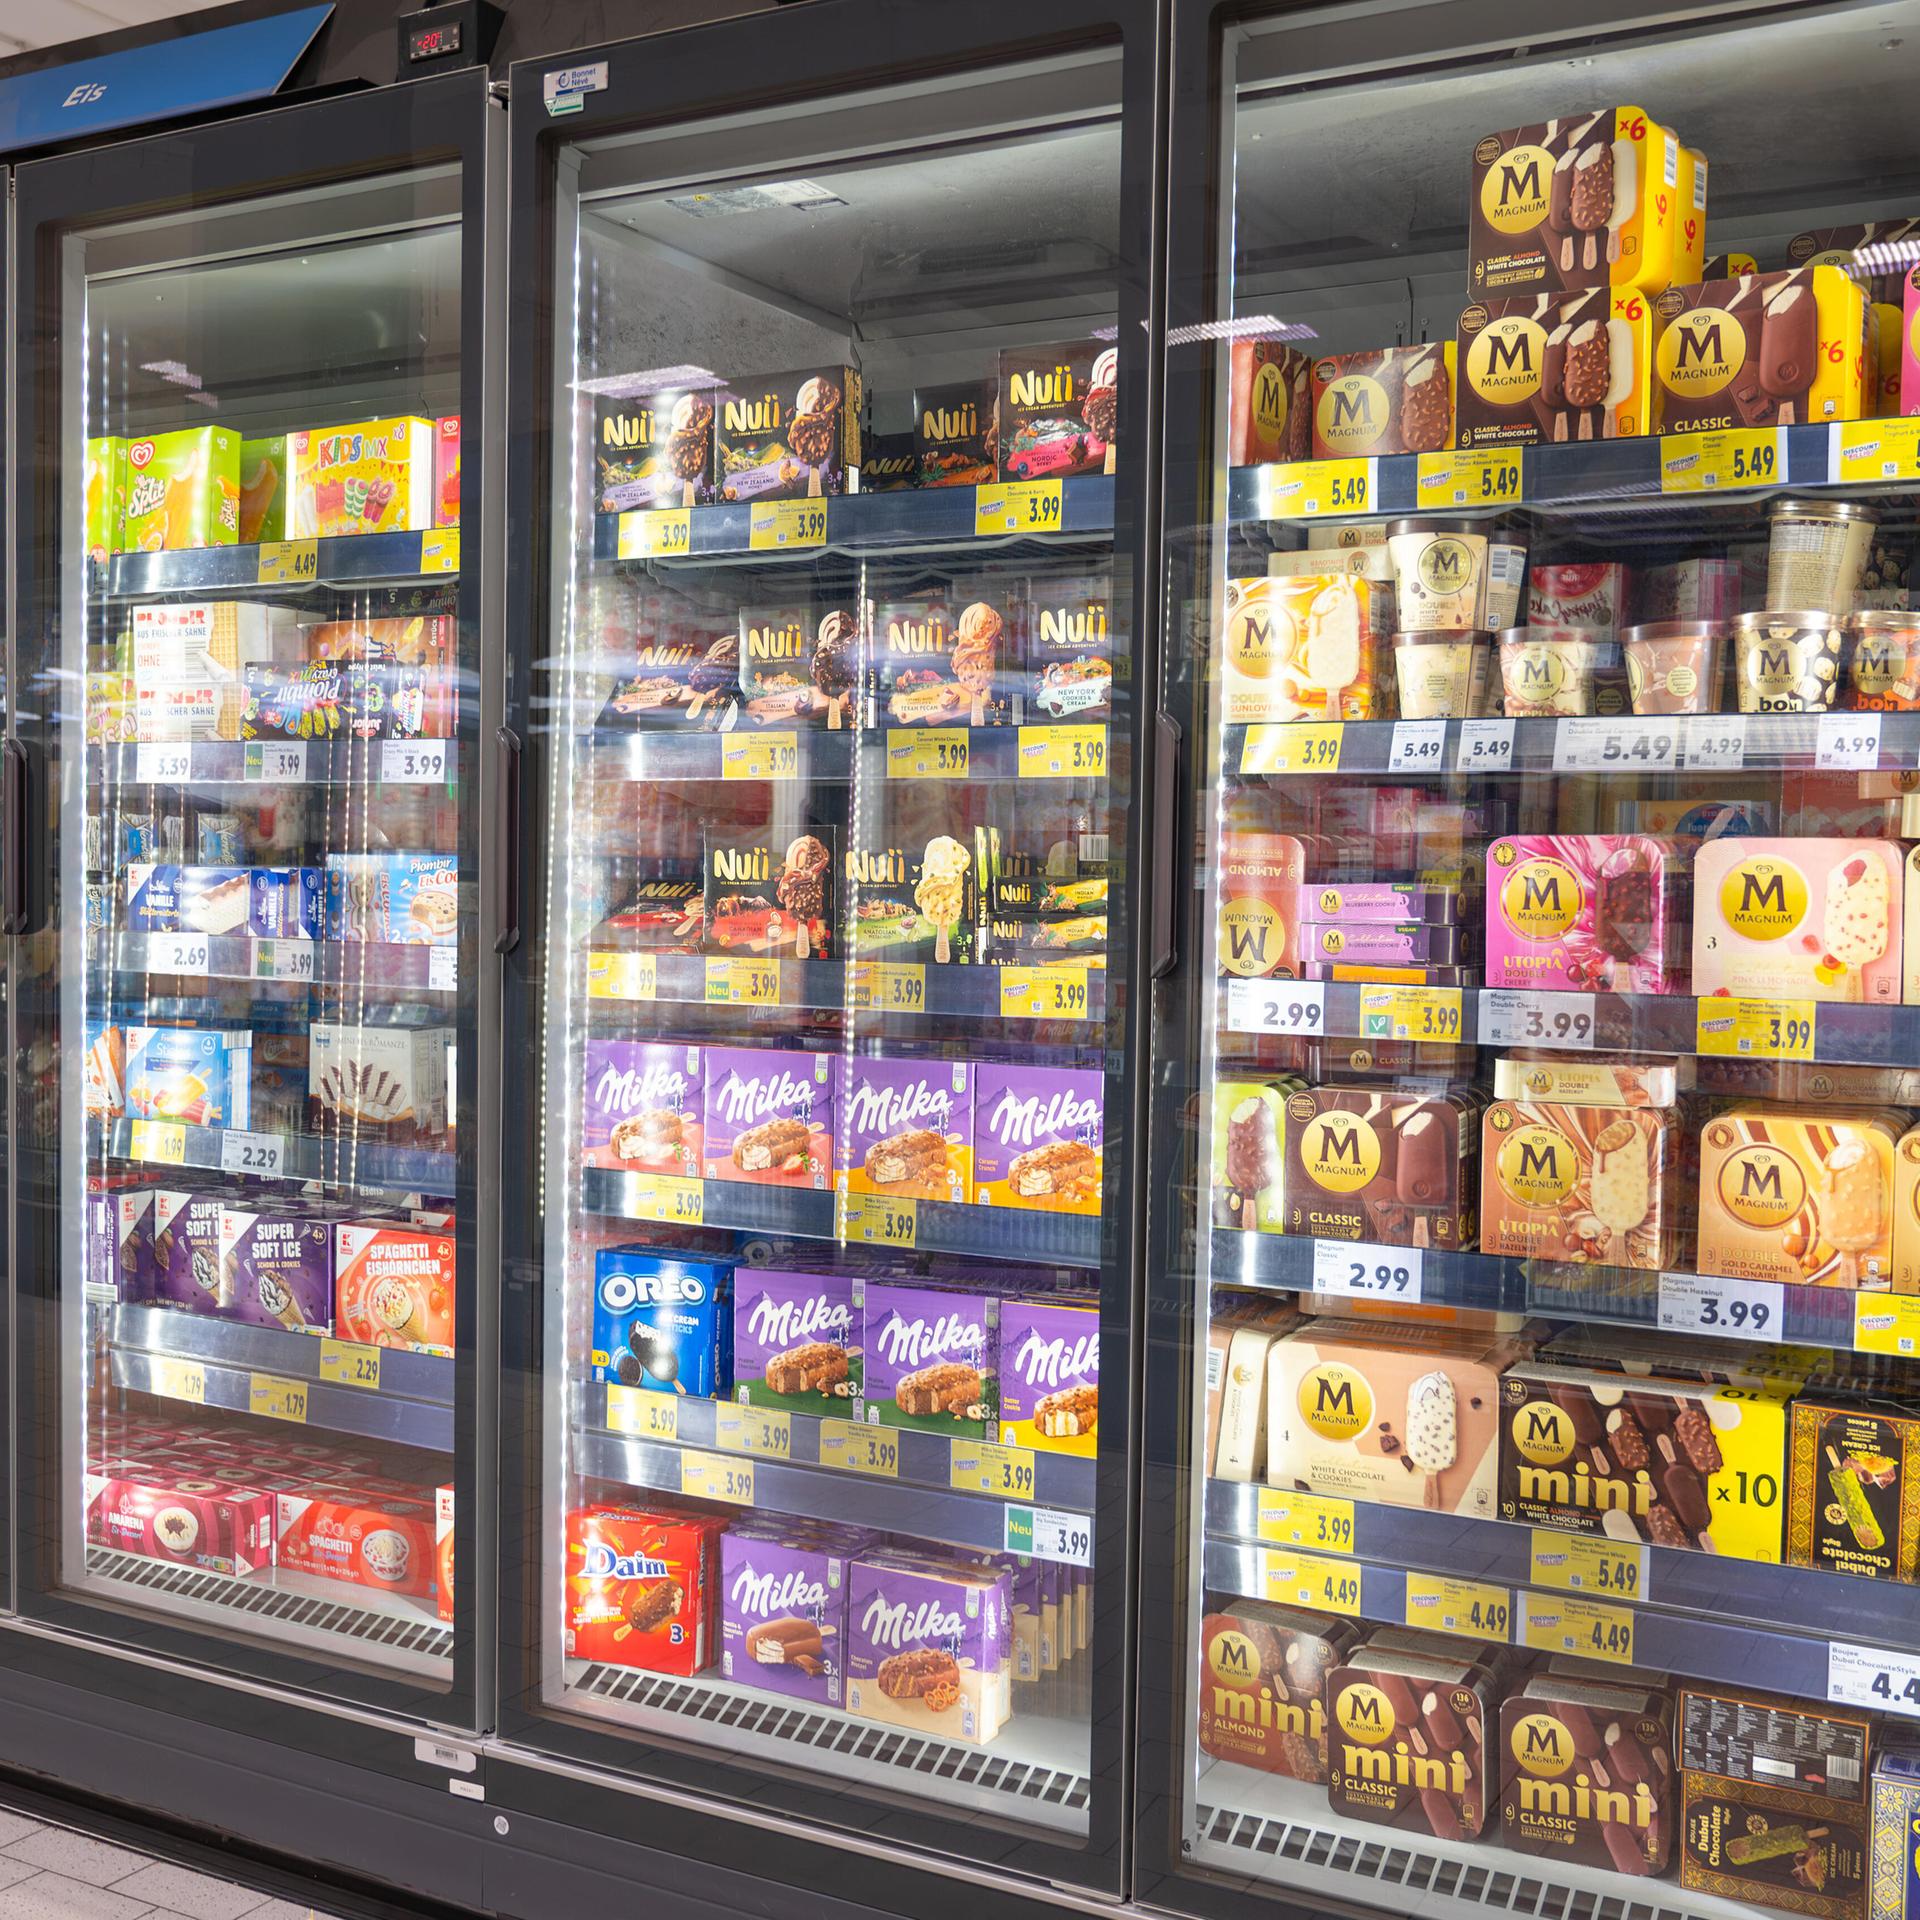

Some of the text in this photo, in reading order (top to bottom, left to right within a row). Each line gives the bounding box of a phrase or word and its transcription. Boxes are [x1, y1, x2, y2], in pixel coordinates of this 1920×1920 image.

[63, 83, 107, 107] Eis
[1493, 200, 1548, 219] MAGNUM
[1486, 250, 1541, 265] CLASSIC ALMOND
[1481, 372, 1539, 388] MAGNUM
[1670, 365, 1731, 381] MAGNUM
[1010, 365, 1073, 407] Nuii
[724, 394, 780, 432] Nuii
[923, 401, 977, 441] Nuii
[1326, 424, 1378, 439] MAGNUM
[320, 434, 362, 470] KIDS
[1702, 441, 1722, 449] Classic
[1031, 454, 1057, 462] NORDIC
[1733, 445, 1774, 479] 5.49
[1331, 477, 1366, 506] 5.49
[1481, 466, 1519, 497] 5.49
[1029, 495, 1059, 523] 3.99
[797, 512, 825, 539] 3.99
[295, 552, 316, 574] 4.49
[1039, 605, 1106, 645] Nuii
[748, 624, 801, 661] Nuii
[889, 618, 943, 654] Nuii
[1520, 682, 1555, 690] MAGNUM
[1756, 675, 1796, 684] MAGNUM
[1856, 674, 1894, 683] MAGNUM
[272, 678, 341, 704] Plombir
[1057, 688, 1096, 696] NEW YORK
[191, 706, 215, 716] SAHNE
[1073, 741, 1104, 767] 3.99
[1472, 740, 1511, 757] 5.49
[1701, 738, 1743, 754] 4.99
[1834, 736, 1877, 753] 4.99
[157, 757, 189, 776] 3.39
[279, 754, 300, 775] 3.99
[404, 755, 443, 775] 3.99
[769, 746, 796, 772] 3.99
[937, 744, 967, 769] 3.99
[410, 858, 453, 873] Plombir
[713, 846, 769, 882] Nuii
[419, 875, 434, 887] Eis
[145, 894, 175, 908] VANILLE
[1000, 883, 1031, 902] Nuii
[267, 891, 278, 930] VANILLE
[1517, 911, 1567, 921] MAGNUM
[1734, 912, 1793, 924] MAGNUM
[992, 920, 1023, 938] Nuii
[290, 954, 312, 975] 3.99
[1503, 953, 1564, 970] UTOPIA
[1503, 978, 1532, 987] CHERRY
[1505, 968, 1547, 978] DOUBLE
[708, 983, 729, 996] Neu
[750, 973, 777, 997] 3.99
[893, 979, 922, 1004] 3.99
[1055, 984, 1085, 1009] 3.99
[1490, 993, 1521, 1001] Magnum
[1490, 1000, 1540, 1010] Double Cherry
[1263, 1001, 1321, 1028] 2.99
[1423, 1006, 1459, 1035] 3.99
[1525, 1012, 1591, 1040] 3.99
[1769, 1019, 1811, 1049] 3.99
[1379, 1057, 1412, 1065] CLASSIC
[595, 1065, 688, 1114] Milka
[716, 1071, 816, 1123] Milka
[849, 1080, 953, 1134] Milka
[989, 1089, 1103, 1146] Milka
[164, 1139, 183, 1156] 1.99
[242, 1146, 277, 1168] 2.29
[978, 1158, 999, 1166] Caramel
[1314, 1163, 1368, 1177] MAGNUM
[1513, 1176, 1563, 1190] MAGNUM
[1734, 1196, 1789, 1211] MAGNUM
[186, 1220, 210, 1237] SOFT
[885, 1213, 914, 1239] 3.99
[1309, 1212, 1362, 1227] CLASSIC
[1499, 1220, 1559, 1237] UTOPIA
[256, 1223, 295, 1241] SUPER
[312, 1231, 324, 1240] 4x
[252, 1241, 302, 1260] SOFT ICE
[370, 1243, 430, 1259] SPAGHETTI
[437, 1246, 450, 1256] 4x
[1316, 1242, 1345, 1253] Magnum
[1316, 1250, 1339, 1259] Classic
[1499, 1242, 1537, 1253] HAZELNUT
[365, 1259, 441, 1275] EISHÖRNCHEN
[1721, 1259, 1794, 1274] GOLD CARAMEL
[1721, 1268, 1778, 1280] BILLIONAIRE
[1349, 1263, 1410, 1292] 2.99
[1662, 1276, 1695, 1286] Magnum
[602, 1275, 704, 1309] OREO
[1662, 1285, 1723, 1298] Double Hazelnut
[747, 1294, 853, 1347] Milka
[1700, 1298, 1771, 1330] 3.99
[1860, 1316, 1896, 1325] DISCOUNT
[877, 1313, 987, 1366] Milka
[597, 1354, 607, 1363] x3
[356, 1358, 378, 1380] 2.29
[184, 1375, 202, 1395] 1.79
[285, 1391, 305, 1416] 1.79
[650, 1407, 675, 1433] 3.99
[1311, 1411, 1360, 1427] MAGNUM
[762, 1424, 789, 1451] 3.99
[1522, 1440, 1566, 1454] MAGNUM
[867, 1442, 896, 1469] 3.99
[1002, 1463, 1032, 1491] 3.99
[1311, 1464, 1386, 1482] WHITE CHOCOLATE
[1318, 1474, 1353, 1484] COOKIES
[726, 1472, 751, 1497] 3.99
[1516, 1461, 1650, 1516] mini
[1519, 1502, 1581, 1518] CLASSIC ALMOND
[1526, 1510, 1594, 1528] WHITE CHOCOLATE
[108, 1511, 145, 1532] AMARENA
[1008, 1520, 1032, 1536] Neu
[1317, 1515, 1351, 1544] 3.99
[309, 1534, 353, 1554] SPAGHETTI
[1058, 1529, 1089, 1555] 3.99
[578, 1537, 669, 1579] Daim
[1822, 1546, 1892, 1568] Chocolate
[1598, 1559, 1637, 1591] 5.49
[731, 1571, 829, 1618] Milka
[1324, 1576, 1358, 1605] 4.49
[862, 1600, 966, 1649] Milka
[1471, 1601, 1507, 1632] 4.49
[1591, 1621, 1631, 1654] 4.49
[1832, 1646, 1859, 1657] Boujee
[1217, 1665, 1253, 1679] MAGNUM
[1832, 1655, 1917, 1675] Dubai ChocolateStyle
[1456, 1692, 1469, 1702] 136
[1346, 1719, 1387, 1734] MAGNUM
[1342, 1742, 1466, 1794] mini
[1521, 1752, 1565, 1767] MAGNUM
[1344, 1778, 1398, 1798] CLASSIC
[1516, 1773, 1651, 1828] mini
[1519, 1812, 1577, 1832] CLASSIC
[1698, 1814, 1710, 1853] Dubai
[1708, 1804, 1722, 1867] Chocolate
